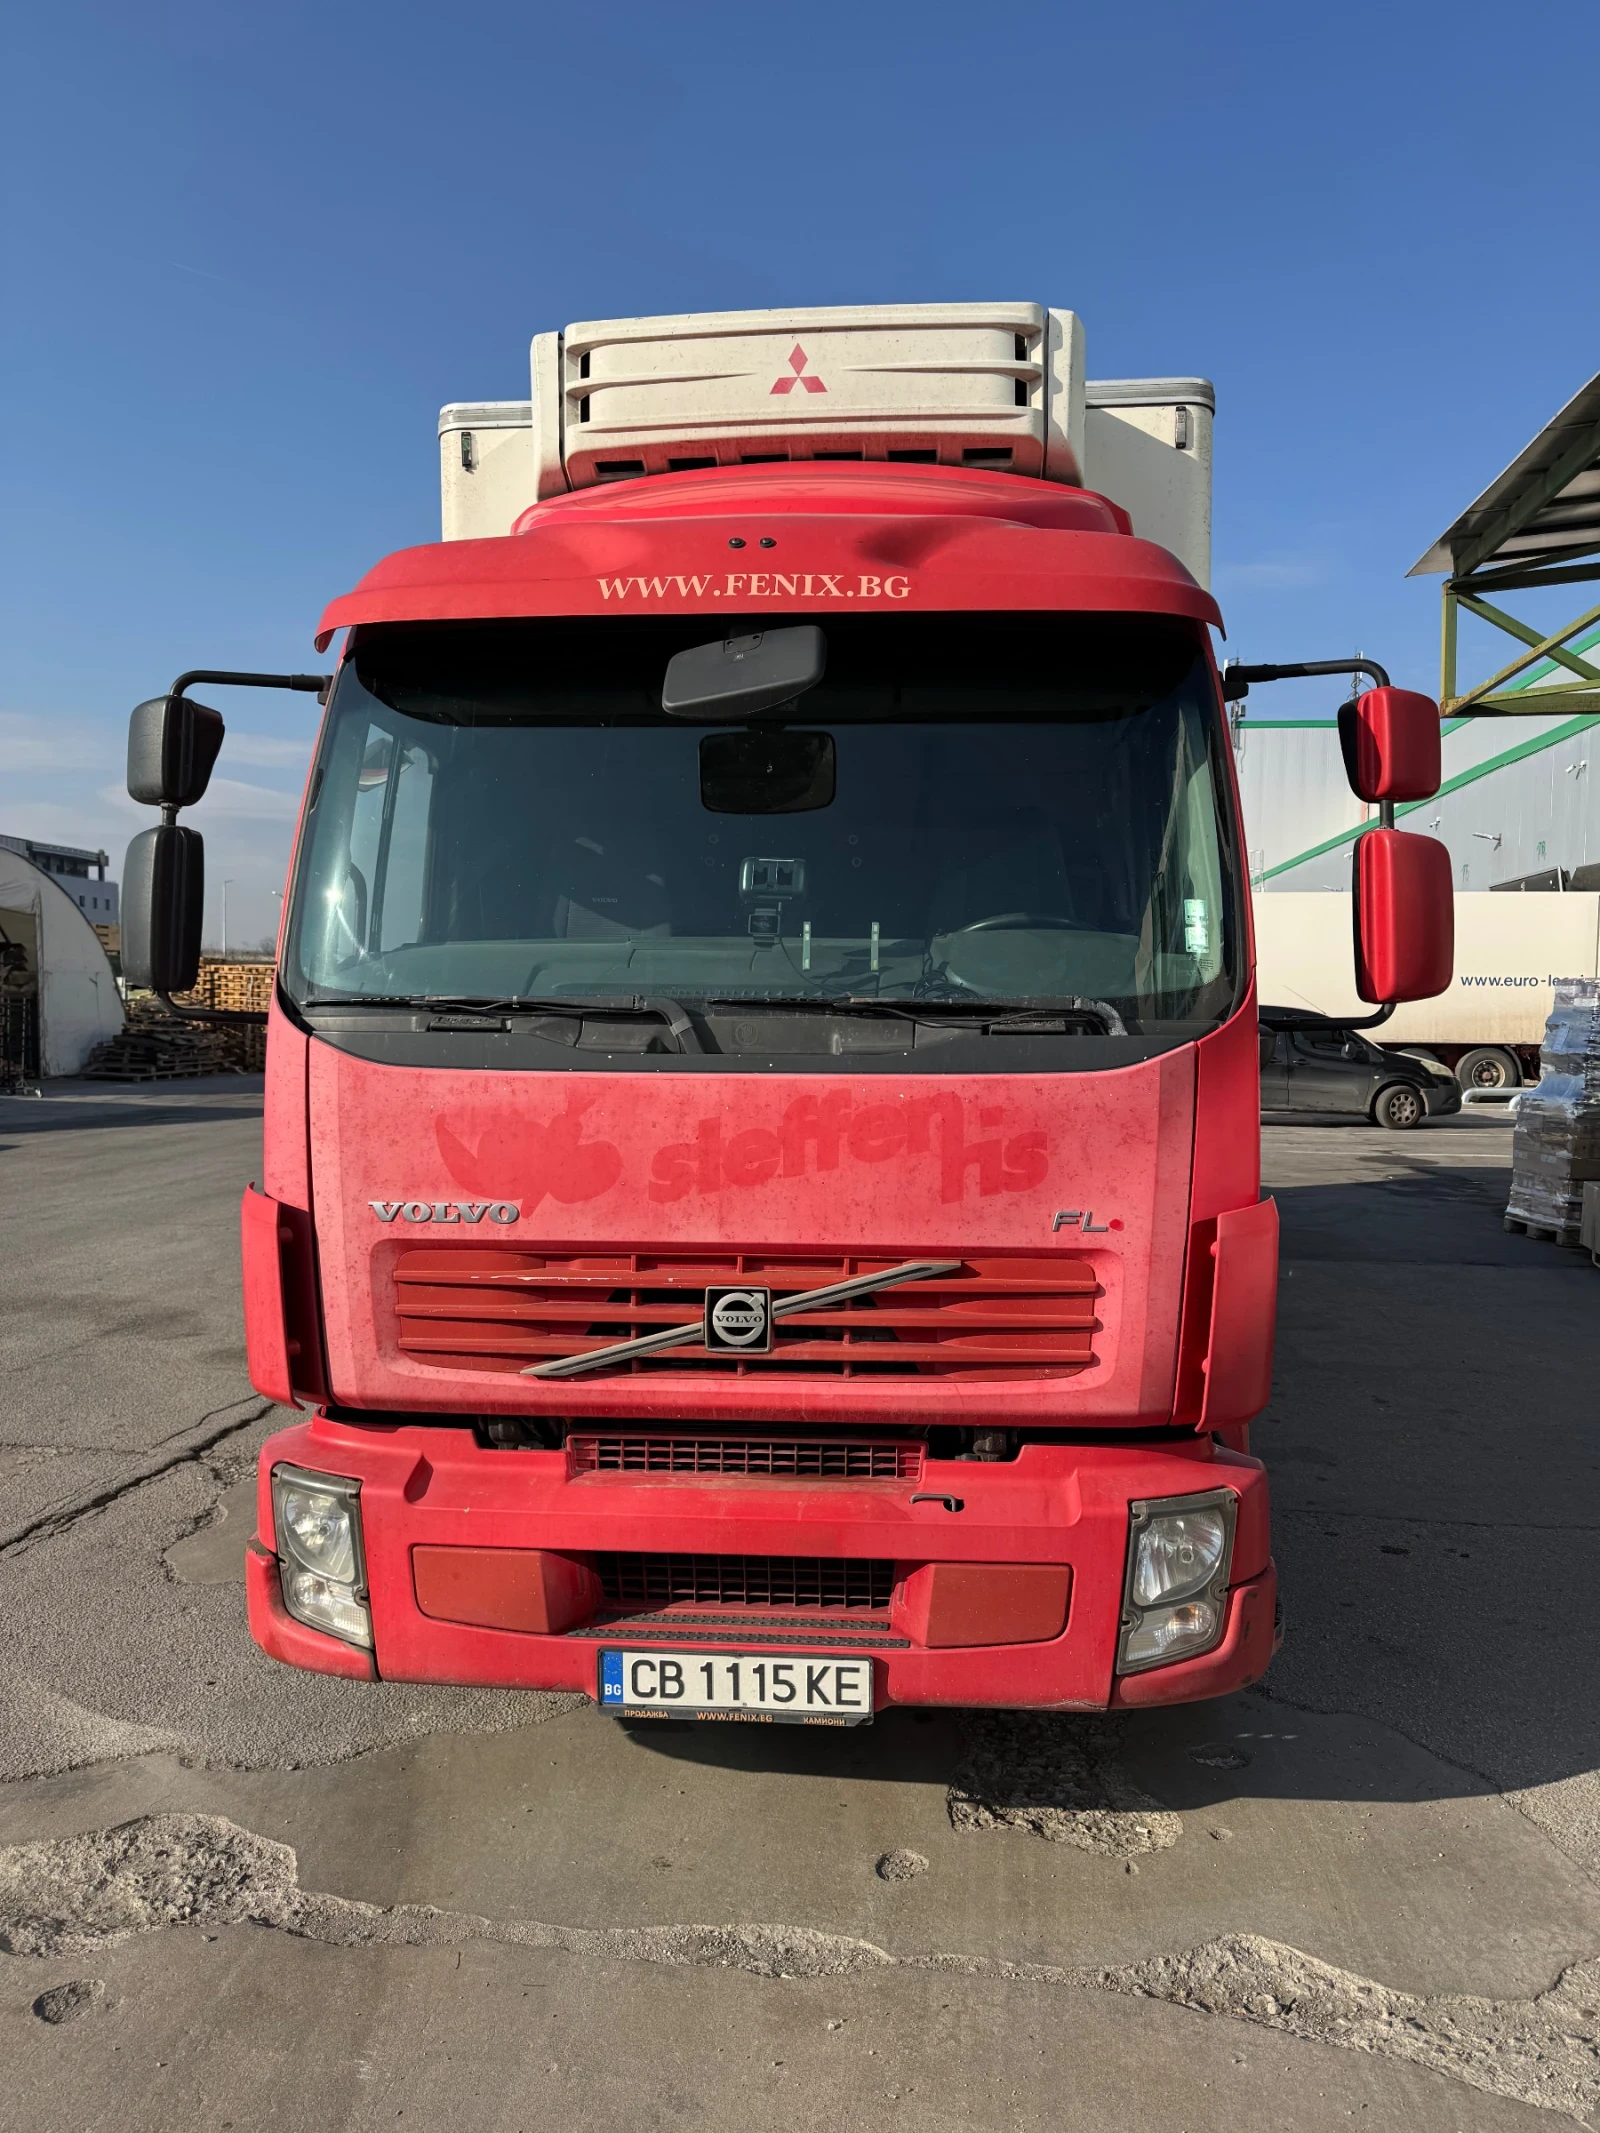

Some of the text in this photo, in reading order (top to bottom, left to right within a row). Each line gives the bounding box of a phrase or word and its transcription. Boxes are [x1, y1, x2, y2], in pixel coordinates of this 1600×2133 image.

[596, 573, 912, 600] WWW.FENIX.BG
[1460, 974, 1584, 988] www.euro-le
[367, 1200, 521, 1225] VOLVO
[1051, 1210, 1110, 1233] FL
[714, 1314, 763, 1324] VOLVO
[604, 1683, 622, 1696] BG
[623, 1709, 669, 1719] ПРОДАЖБА
[803, 1716, 845, 1726] КАМИОНИ
